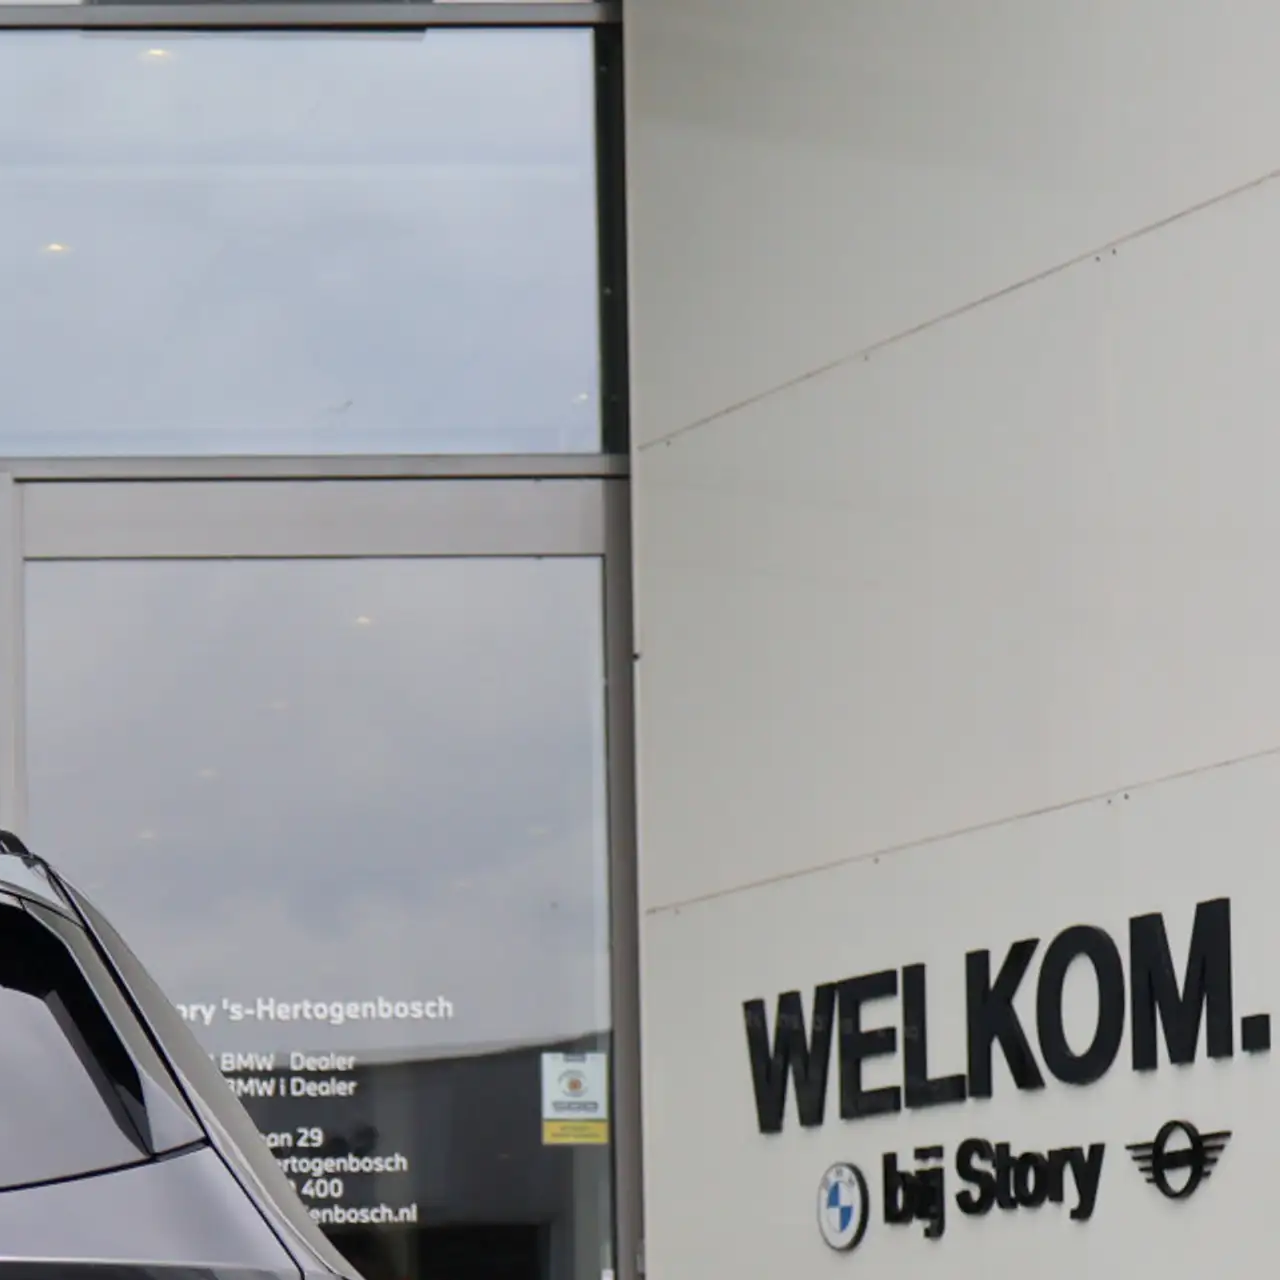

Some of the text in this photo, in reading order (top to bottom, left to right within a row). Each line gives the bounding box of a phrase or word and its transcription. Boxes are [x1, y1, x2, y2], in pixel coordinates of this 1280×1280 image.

[222, 997, 454, 1025] 's-Hertogenbosch
[743, 897, 1270, 1134] WELKOM.
[220, 1052, 356, 1072] BMW Dealer
[280, 1077, 285, 1096] i
[290, 1077, 357, 1097] Dealer
[296, 1127, 325, 1148] 29
[301, 1179, 343, 1198] 400
[882, 1138, 1106, 1238] bij Story
